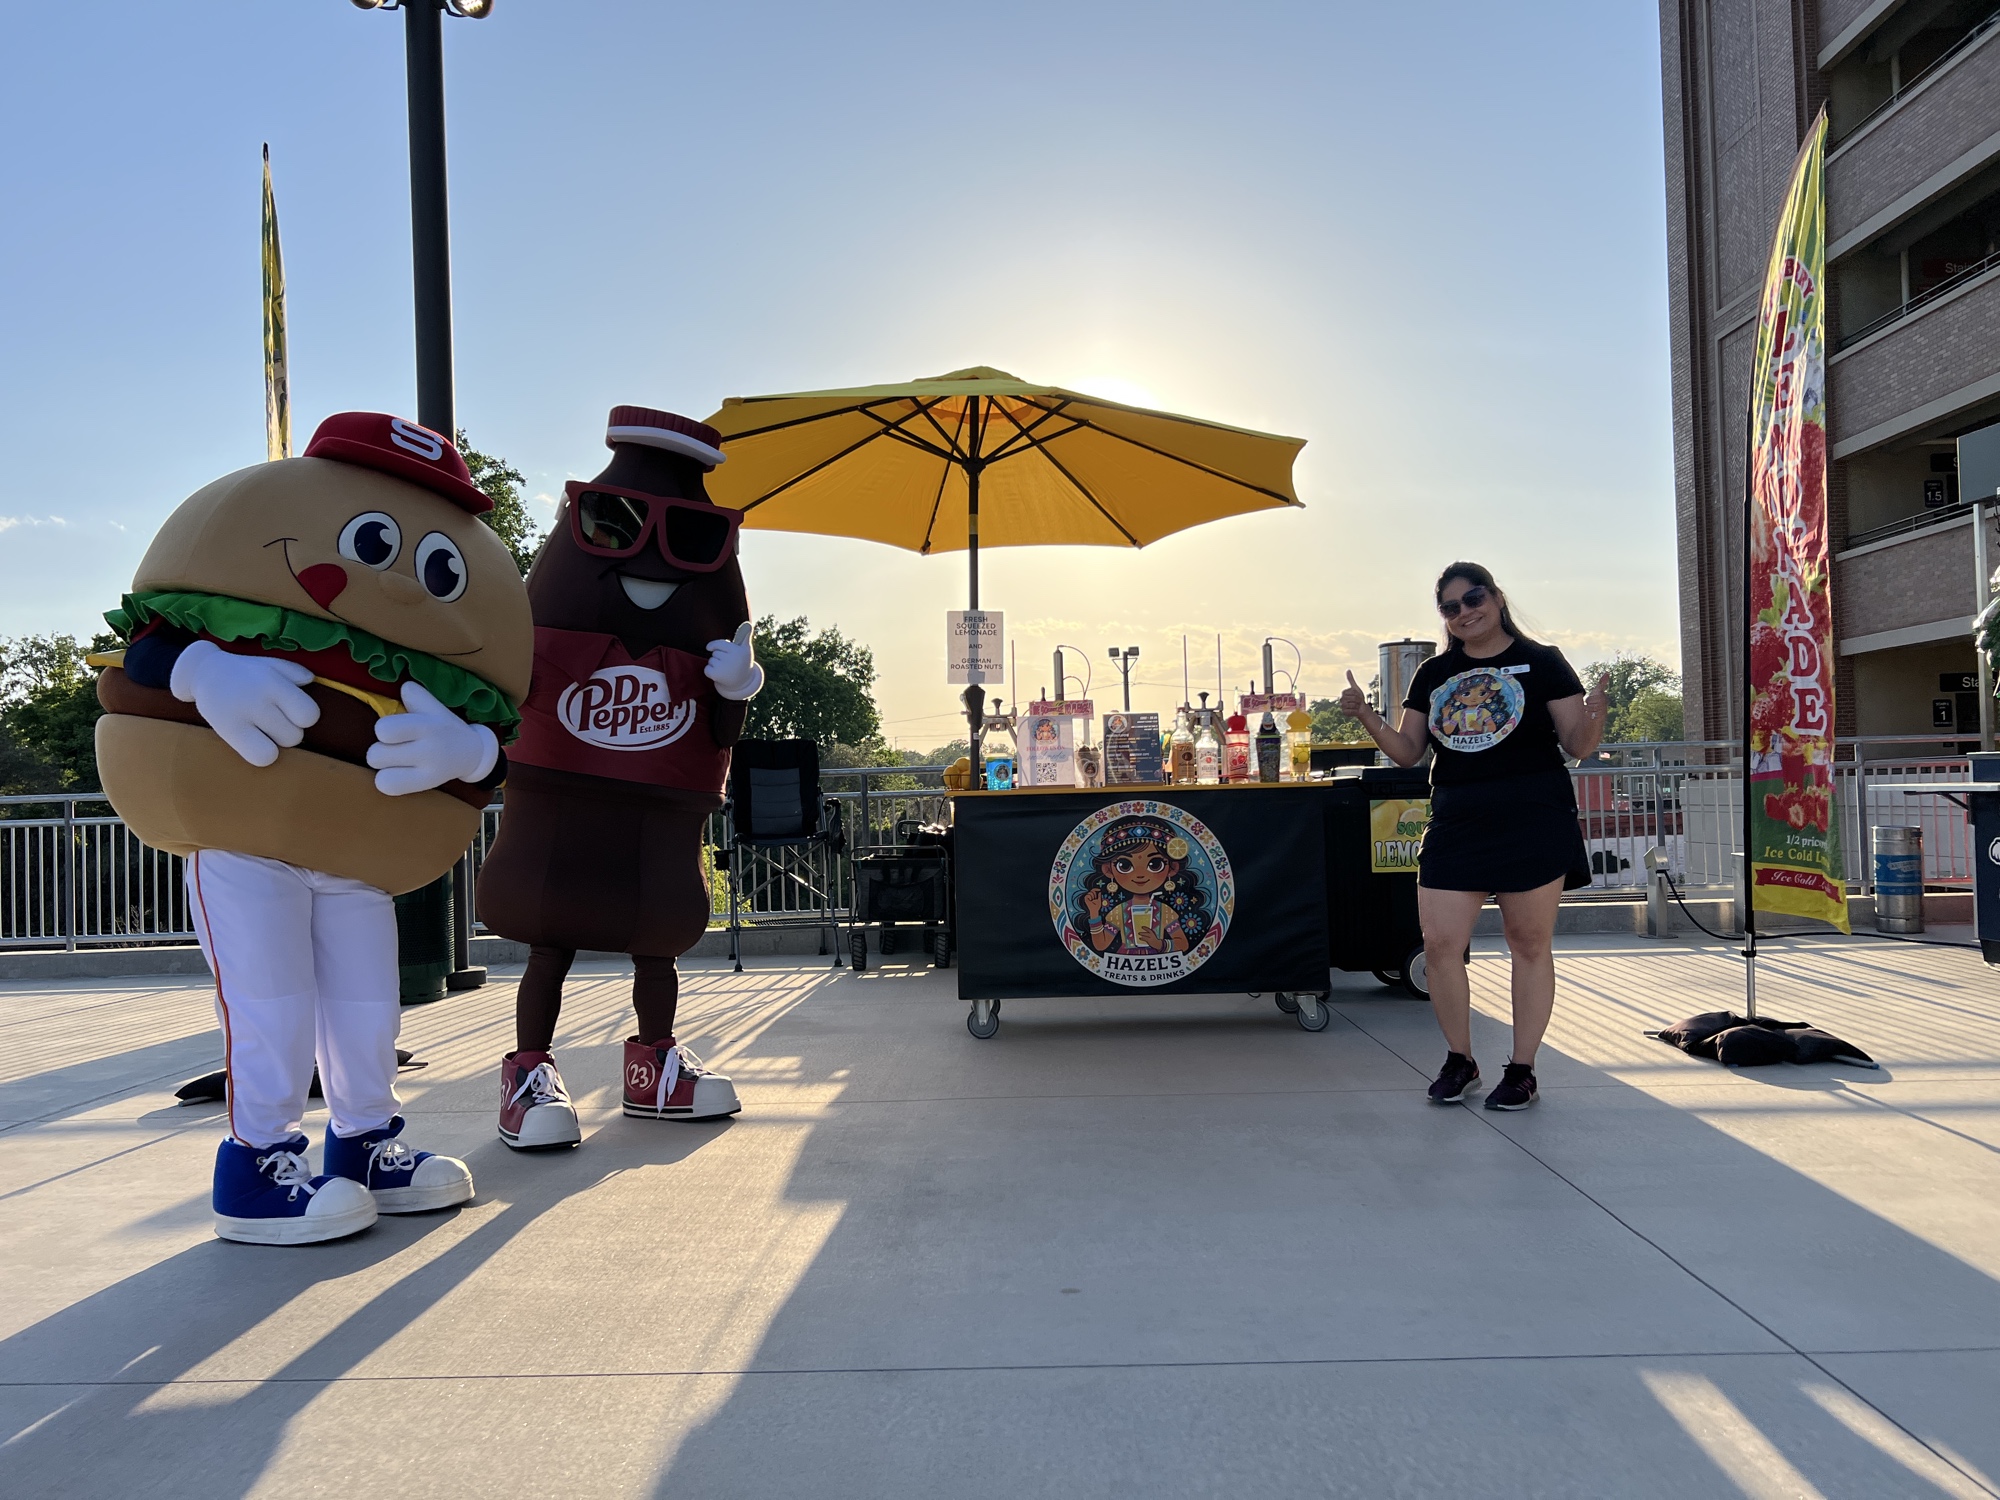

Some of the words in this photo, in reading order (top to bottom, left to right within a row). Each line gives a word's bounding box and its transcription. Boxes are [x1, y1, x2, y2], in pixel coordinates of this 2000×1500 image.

[390, 418, 444, 461] S
[1927, 491, 1942, 501] 1.5
[1962, 676, 1996, 688] Stas
[612, 674, 658, 707] Dr
[577, 678, 683, 738] Pepper
[1786, 835, 1800, 845] 1/2
[1764, 846, 1784, 858] Ice
[1788, 848, 1813, 862] Cold
[1771, 871, 1792, 883] Ice
[1794, 873, 1817, 886] Cold
[1106, 955, 1182, 971] HAZEL'S
[1104, 970, 1138, 981] TREATS
[1150, 969, 1185, 981] DRINKS
